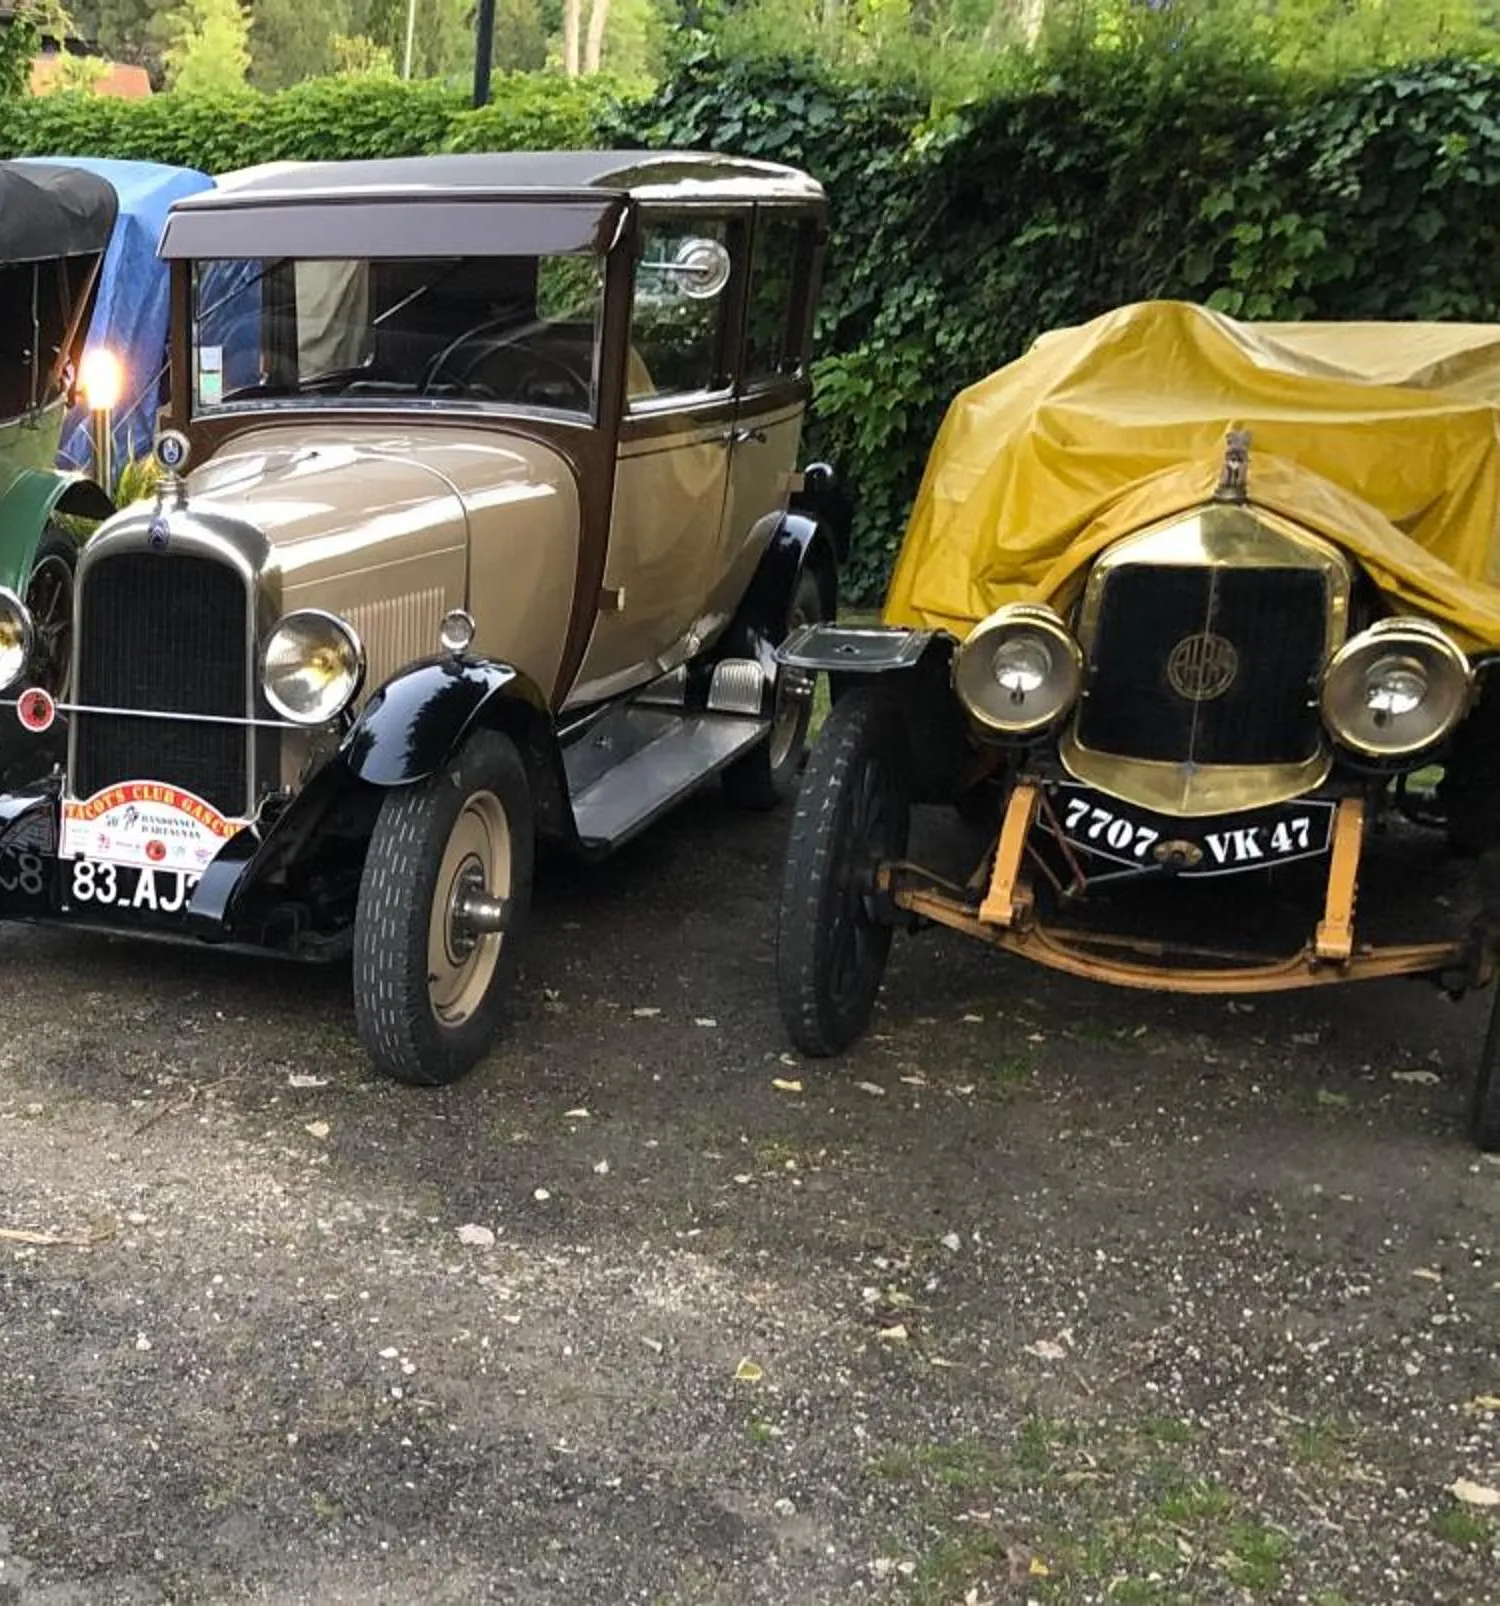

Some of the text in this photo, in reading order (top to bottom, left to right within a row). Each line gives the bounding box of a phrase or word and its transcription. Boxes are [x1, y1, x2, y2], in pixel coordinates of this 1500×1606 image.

[132, 785, 176, 805] CLUB
[1064, 798, 1310, 864] 7707 VK 47
